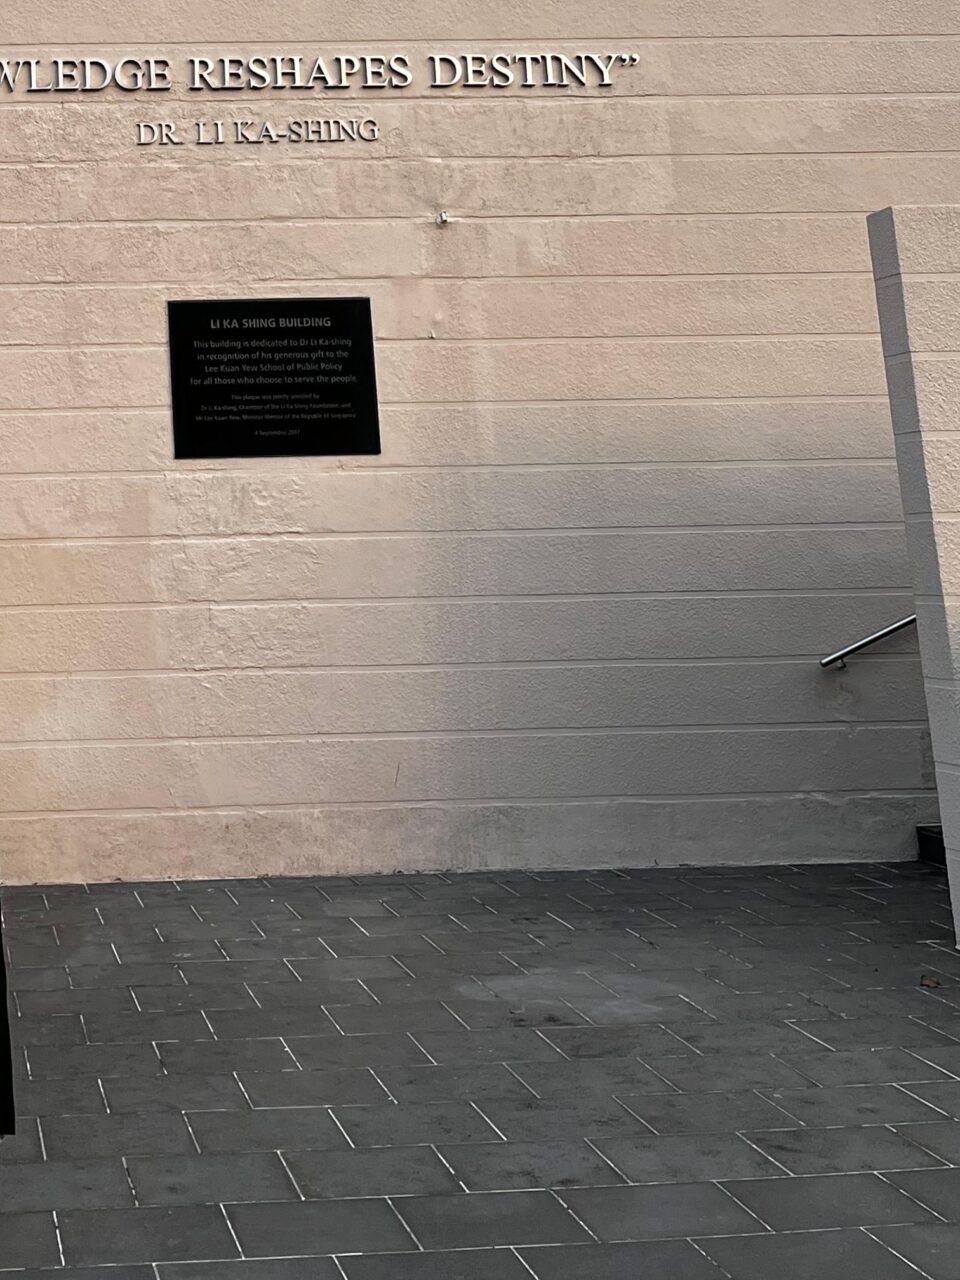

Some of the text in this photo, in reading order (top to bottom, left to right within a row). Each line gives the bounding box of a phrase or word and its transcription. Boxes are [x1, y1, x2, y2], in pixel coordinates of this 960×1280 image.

[189, 54, 413, 91] RESHAPES
[429, 52, 641, 89] DESTINY”
[195, 120, 225, 145] LI
[234, 118, 380, 144] KA-SHING
[210, 317, 332, 329] LI KA SHING BUILDING
[193, 340, 209, 348] This
[210, 339, 241, 350] building
[243, 340, 250, 348] is
[250, 339, 287, 348] dedicated
[289, 339, 298, 347] to
[310, 338, 318, 346] Li
[197, 350, 349, 362] in recognition of his generous gift to the
[204, 365, 219, 373] Lee
[220, 364, 240, 373] Kuan
[241, 363, 258, 372] Yew
[259, 363, 285, 372] School
[286, 363, 295, 371] of
[320, 362, 343, 372] Policy
[203, 376, 213, 385] all
[214, 376, 236, 385] those
[237, 376, 255, 385] who
[255, 375, 282, 384] choose
[284, 376, 293, 384] to
